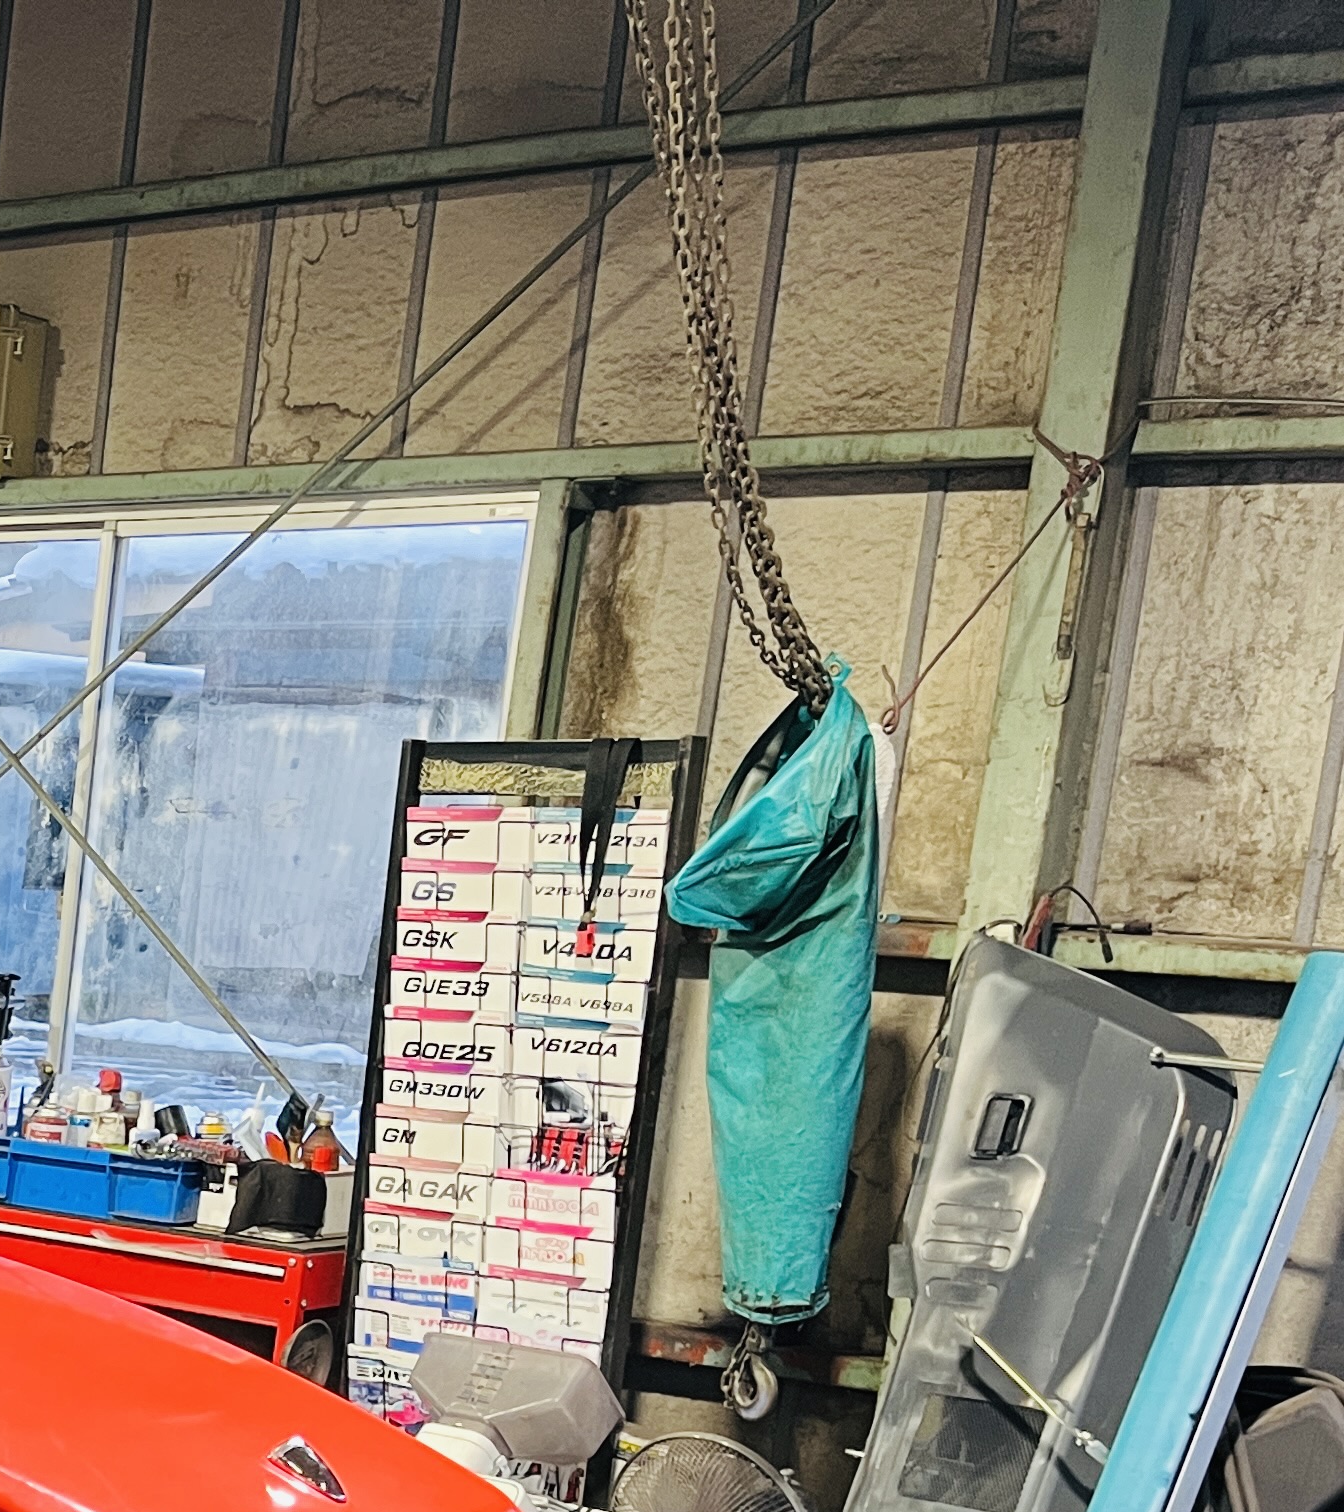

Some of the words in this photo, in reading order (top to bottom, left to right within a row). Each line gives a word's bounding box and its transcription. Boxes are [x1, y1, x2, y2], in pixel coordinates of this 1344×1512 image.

[413, 828, 471, 847] GF
[412, 880, 457, 902] GS
[402, 929, 459, 950] GSK
[543, 940, 632, 962] V40A
[531, 1036, 618, 1058] V6120A
[389, 1078, 486, 1100] GM330W
[382, 1127, 417, 1145] GM
[375, 1175, 413, 1196] GA
[419, 1180, 479, 1203] GAK
